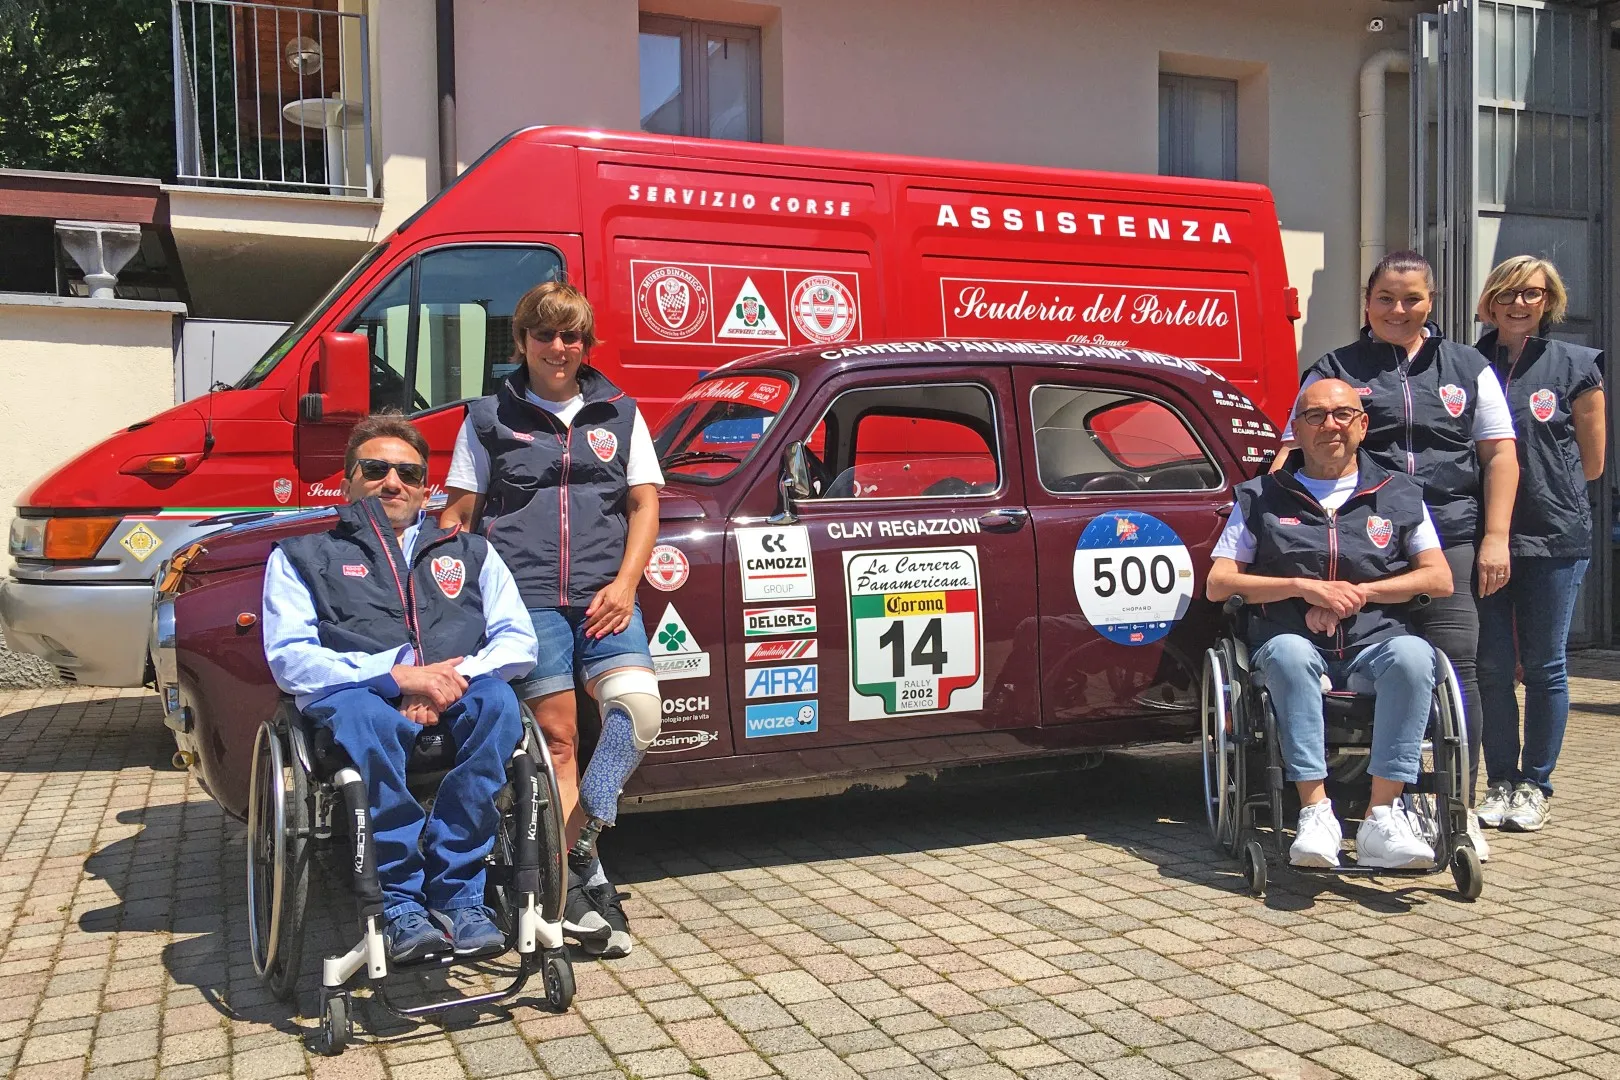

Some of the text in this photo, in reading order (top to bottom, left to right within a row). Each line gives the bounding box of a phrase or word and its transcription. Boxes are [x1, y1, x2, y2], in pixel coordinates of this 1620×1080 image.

[628, 184, 851, 217] SERVIZIO CORSE
[936, 204, 1232, 244] ASSISTENZA
[642, 269, 702, 292] MUSEO DINAMICO
[953, 286, 1229, 327] Scuderia del Portello
[1093, 334, 1129, 347] Romeo
[820, 341, 942, 360] CARRERA
[948, 341, 1132, 361] PANAMERICANA
[827, 517, 981, 539] CLAY REGAZZONI
[746, 557, 807, 571] CAMOZZI
[863, 556, 961, 576] La Carrera
[856, 575, 969, 592] Panamericana
[1093, 554, 1176, 598] 500
[763, 583, 795, 594] GROUP
[886, 596, 945, 615] Corona
[879, 617, 948, 678] 14
[747, 666, 817, 697] AFRA
[903, 679, 931, 688] RALLY
[901, 688, 934, 700] 2002
[662, 695, 710, 714] OSCH
[900, 699, 934, 709] MEXICO
[682, 715, 693, 723] per
[748, 714, 795, 731] waze
